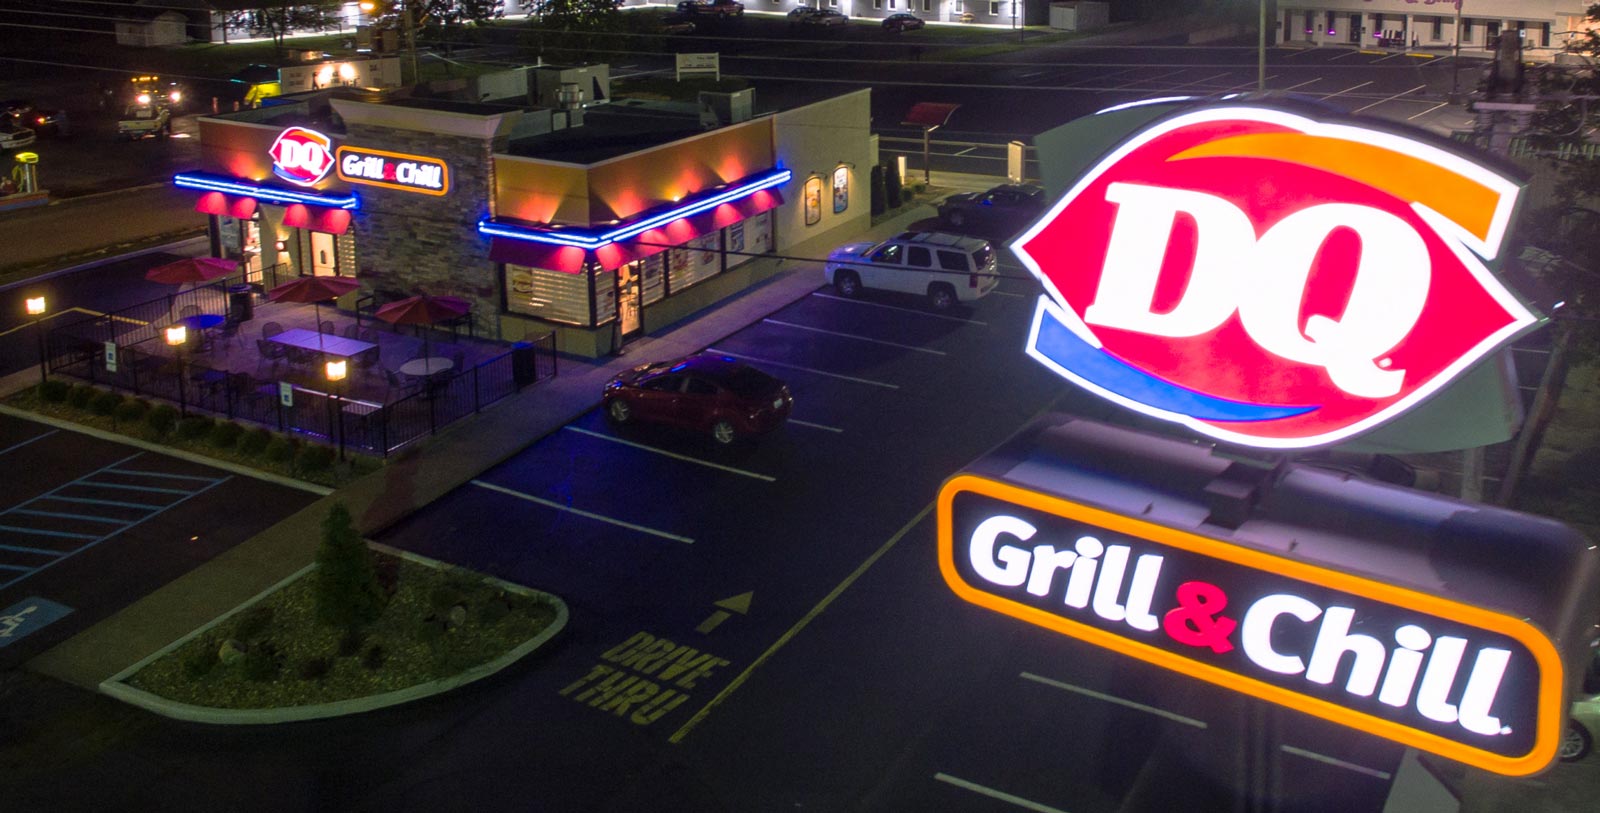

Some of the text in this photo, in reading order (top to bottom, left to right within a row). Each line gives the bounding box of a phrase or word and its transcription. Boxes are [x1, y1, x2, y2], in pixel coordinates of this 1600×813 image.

[280, 138, 324, 175] DQ
[1085, 182, 1431, 398] DQ
[600, 631, 731, 689] DRIVE
[558, 664, 691, 725] THRU
